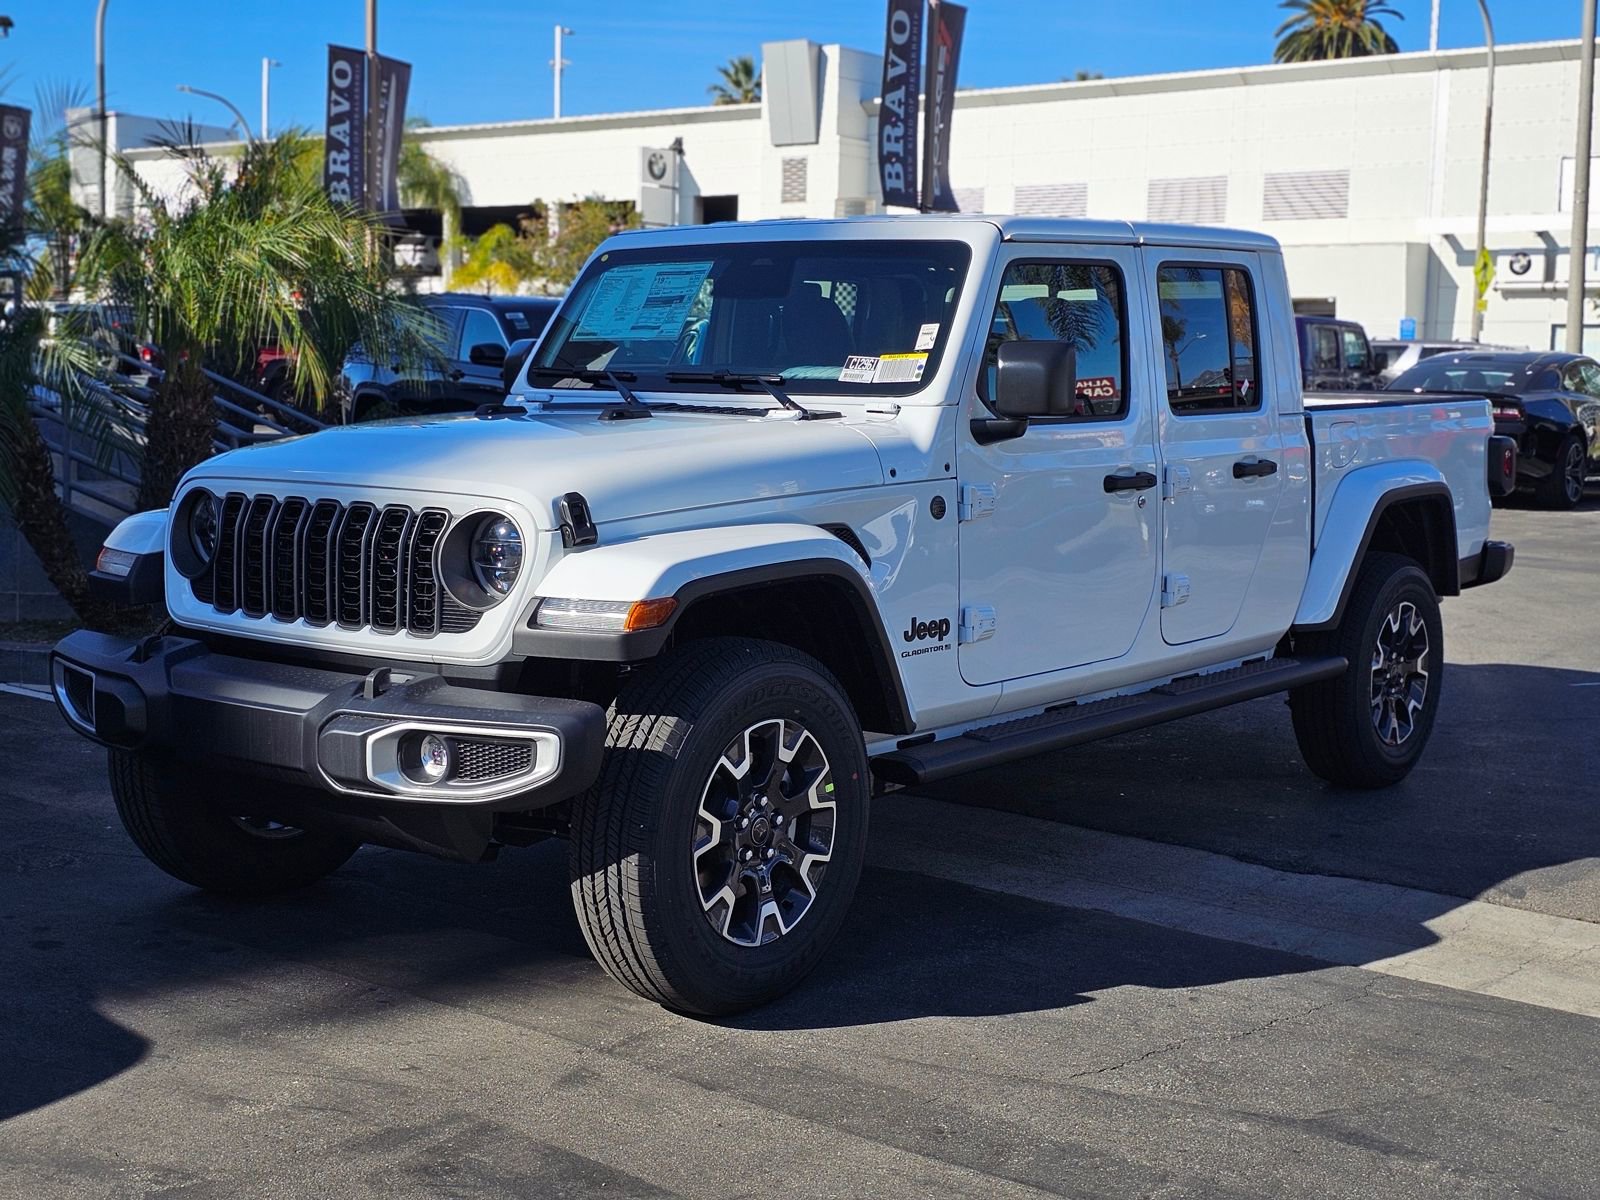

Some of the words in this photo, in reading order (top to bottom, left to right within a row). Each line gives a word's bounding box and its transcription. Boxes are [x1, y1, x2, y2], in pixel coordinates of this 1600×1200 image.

[908, 12, 920, 93] DEALERSHIP
[330, 60, 352, 203] BRAVO
[884, 10, 910, 192] BRAVO
[908, 97, 915, 113] OF
[932, 45, 947, 197] DODGE
[901, 645, 944, 658] GLADIATOR
[904, 617, 950, 642] Jeep
